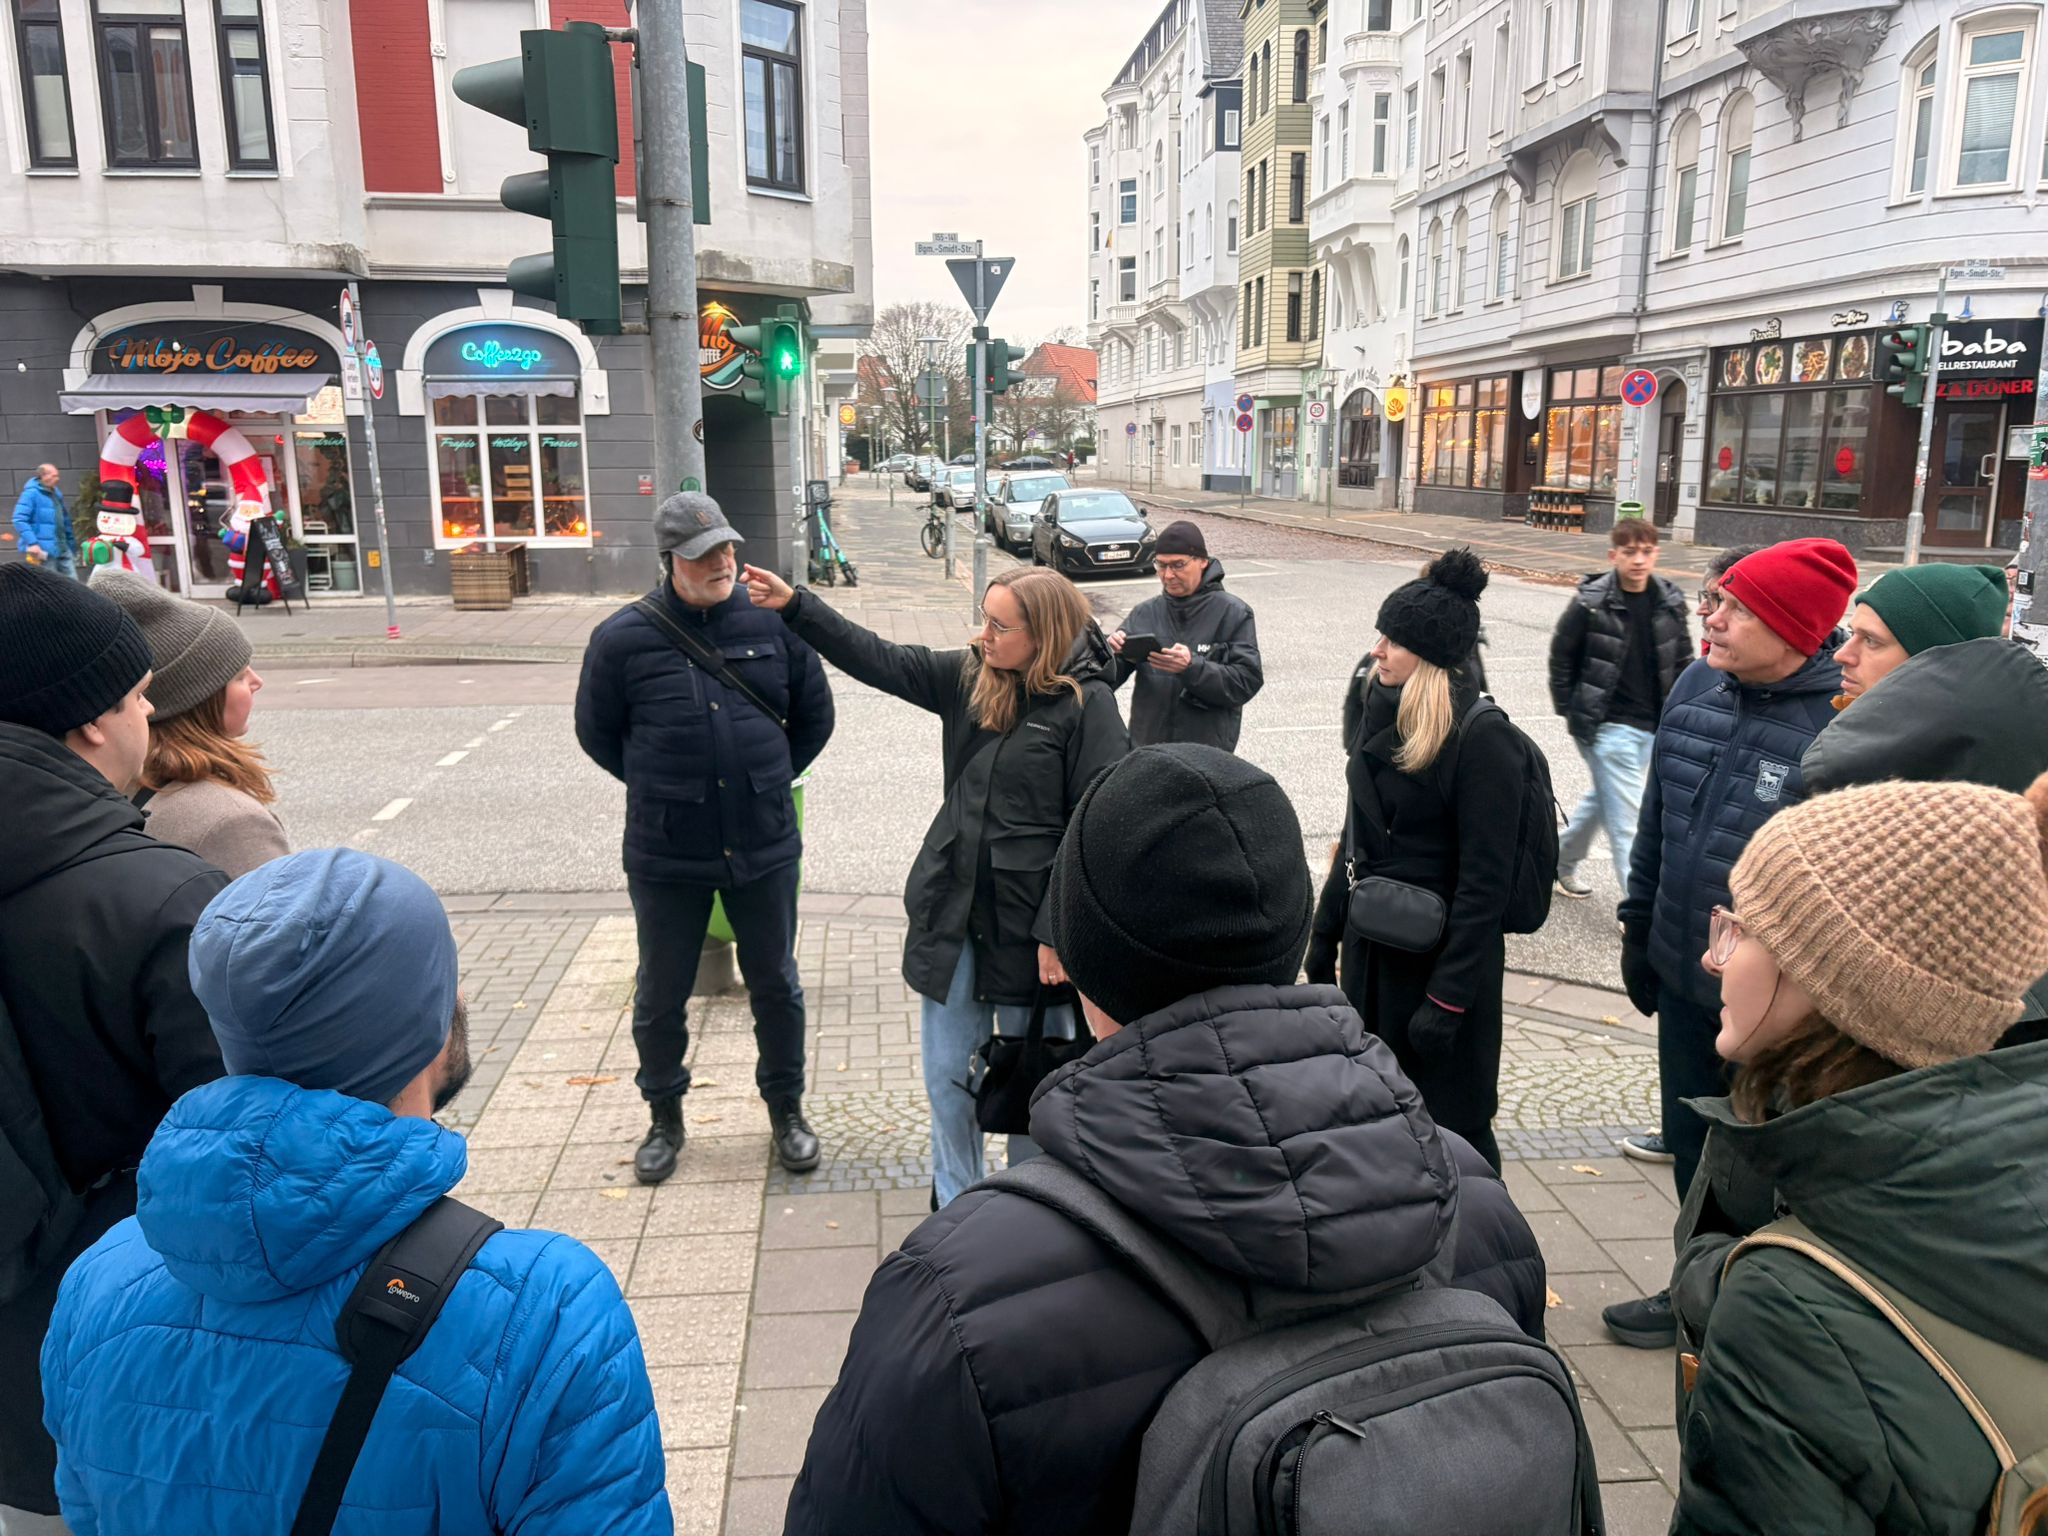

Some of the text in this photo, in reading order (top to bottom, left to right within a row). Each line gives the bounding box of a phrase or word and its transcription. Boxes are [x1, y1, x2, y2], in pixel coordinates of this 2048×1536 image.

[917, 244, 974, 255] Bgm.-Smidt-Str.
[109, 336, 318, 374] Mojo Coffee
[462, 340, 541, 370] Coffee2go
[700, 348, 721, 365] OFFEE
[1967, 378, 2033, 397] DÖNER
[388, 1286, 420, 1303] Lowepro
